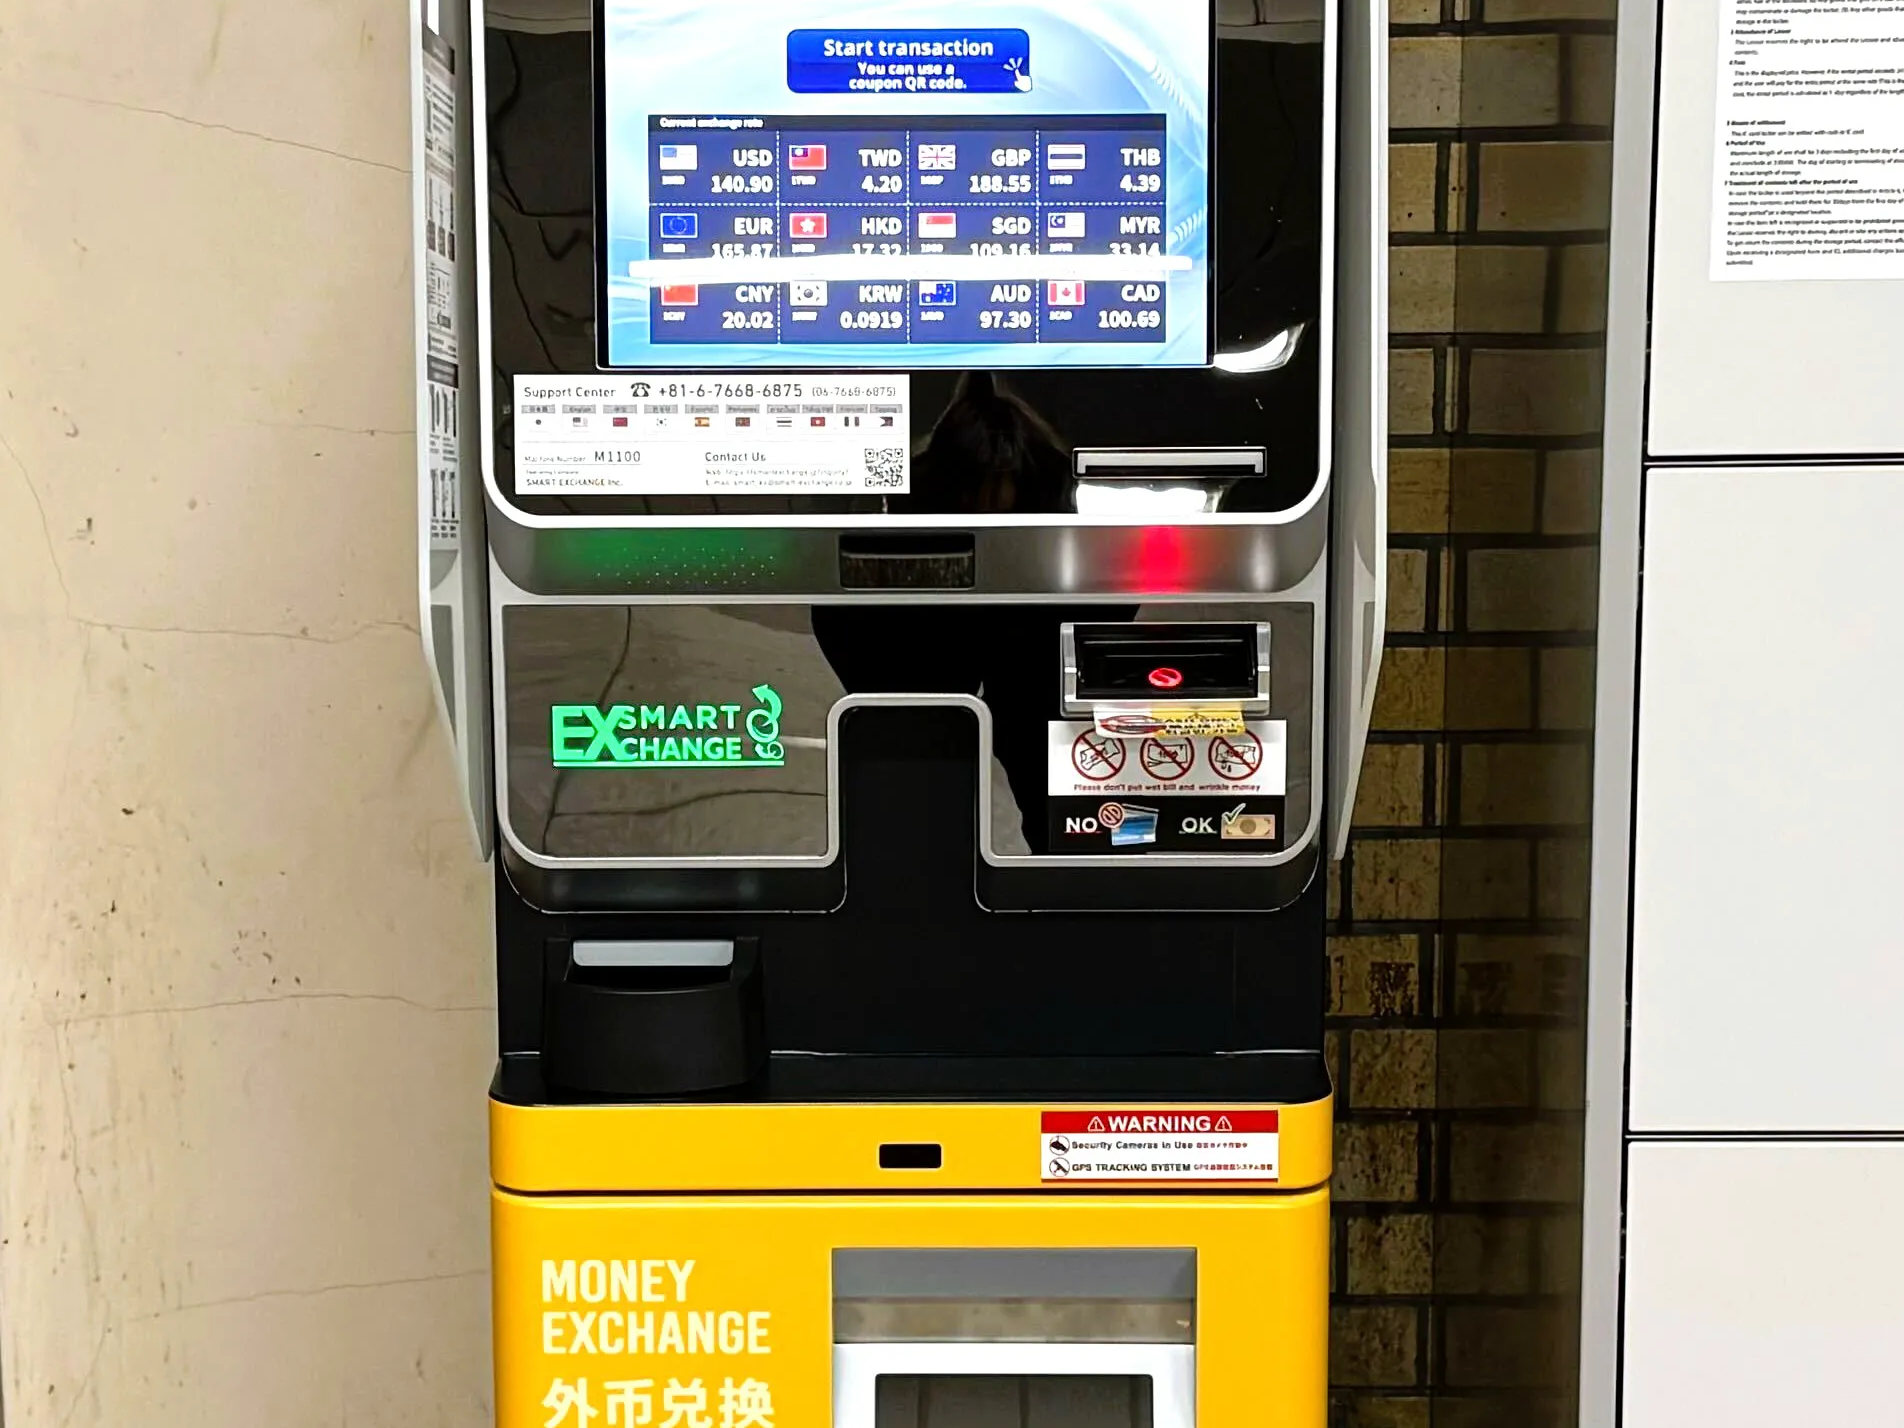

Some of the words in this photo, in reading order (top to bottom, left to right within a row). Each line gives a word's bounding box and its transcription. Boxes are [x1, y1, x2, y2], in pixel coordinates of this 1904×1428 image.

[823, 38, 874, 57] Start
[878, 38, 994, 57] transaction
[857, 61, 886, 76] You
[888, 64, 915, 76] can
[917, 63, 943, 76] use
[945, 63, 955, 75] a
[848, 78, 903, 93] coupon
[904, 75, 927, 92] QR
[928, 75, 967, 90] code.
[733, 148, 773, 167] USD
[858, 148, 903, 167] TWD
[991, 148, 1032, 167] GBP
[1120, 148, 1161, 167] THB
[711, 175, 774, 193] 140.90
[861, 175, 903, 193] 4.20
[969, 174, 1032, 193] 188.55
[1119, 174, 1161, 193] 4.39
[734, 217, 774, 235] EUR
[861, 216, 903, 236] HKD
[991, 216, 1032, 235] SGD
[1119, 216, 1161, 235] MYR
[735, 284, 775, 303] CNY
[859, 284, 903, 303] KRW
[990, 284, 1032, 303] AUD
[1121, 284, 1161, 302] CAD
[722, 311, 774, 329] 20.02
[839, 310, 903, 329] 0.0919
[979, 310, 1032, 329] 97.30
[1098, 310, 1161, 329] 100.69
[523, 386, 572, 399] Support
[575, 386, 617, 398] Center
[659, 383, 803, 398] +81-6-7668-6875
[594, 450, 641, 463] M1100
[704, 451, 748, 462] Contact
[751, 451, 767, 462] Us
[618, 705, 741, 730] SMART
[622, 737, 742, 761] CHANGE
[1065, 817, 1098, 833] NO
[1181, 817, 1214, 833] OK
[1107, 1115, 1211, 1132] WARNING
[1071, 1140, 1113, 1151] Security
[1115, 1140, 1158, 1150] Cameras
[1174, 1141, 1194, 1150] Use
[1071, 1163, 1092, 1172] GPS
[1095, 1163, 1148, 1172] TRACKING
[1151, 1163, 1191, 1172] SYSTEM
[541, 1259, 696, 1303] MONEY
[542, 1310, 771, 1355] EXCHANGE
